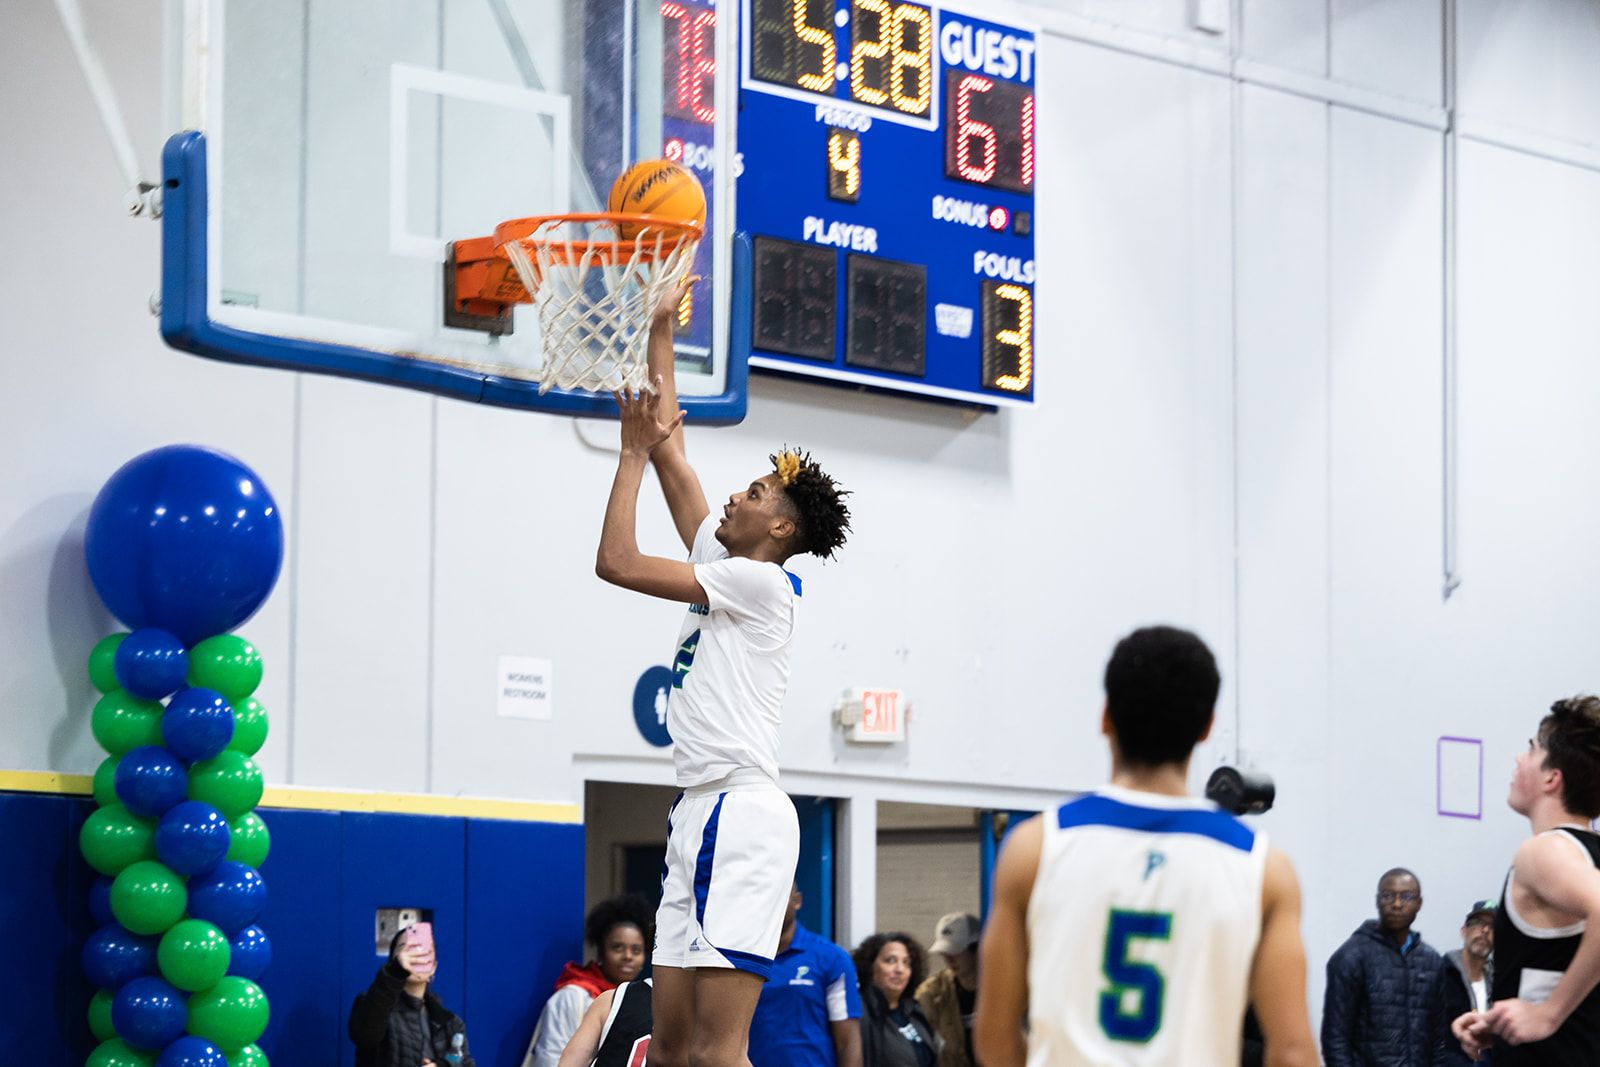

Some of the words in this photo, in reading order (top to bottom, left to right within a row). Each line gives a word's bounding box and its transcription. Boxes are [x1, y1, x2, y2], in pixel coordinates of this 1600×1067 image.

[940, 20, 1035, 82] GUEST
[957, 74, 1034, 185] 61
[828, 133, 860, 195] 4
[803, 215, 878, 253] PLAYER
[932, 194, 988, 229] BONUS
[973, 250, 1036, 284] FOULS
[994, 284, 1033, 391] 3
[503, 687, 547, 701] RESTROOM
[862, 691, 899, 733] EXIT
[1099, 908, 1173, 1044] 5
